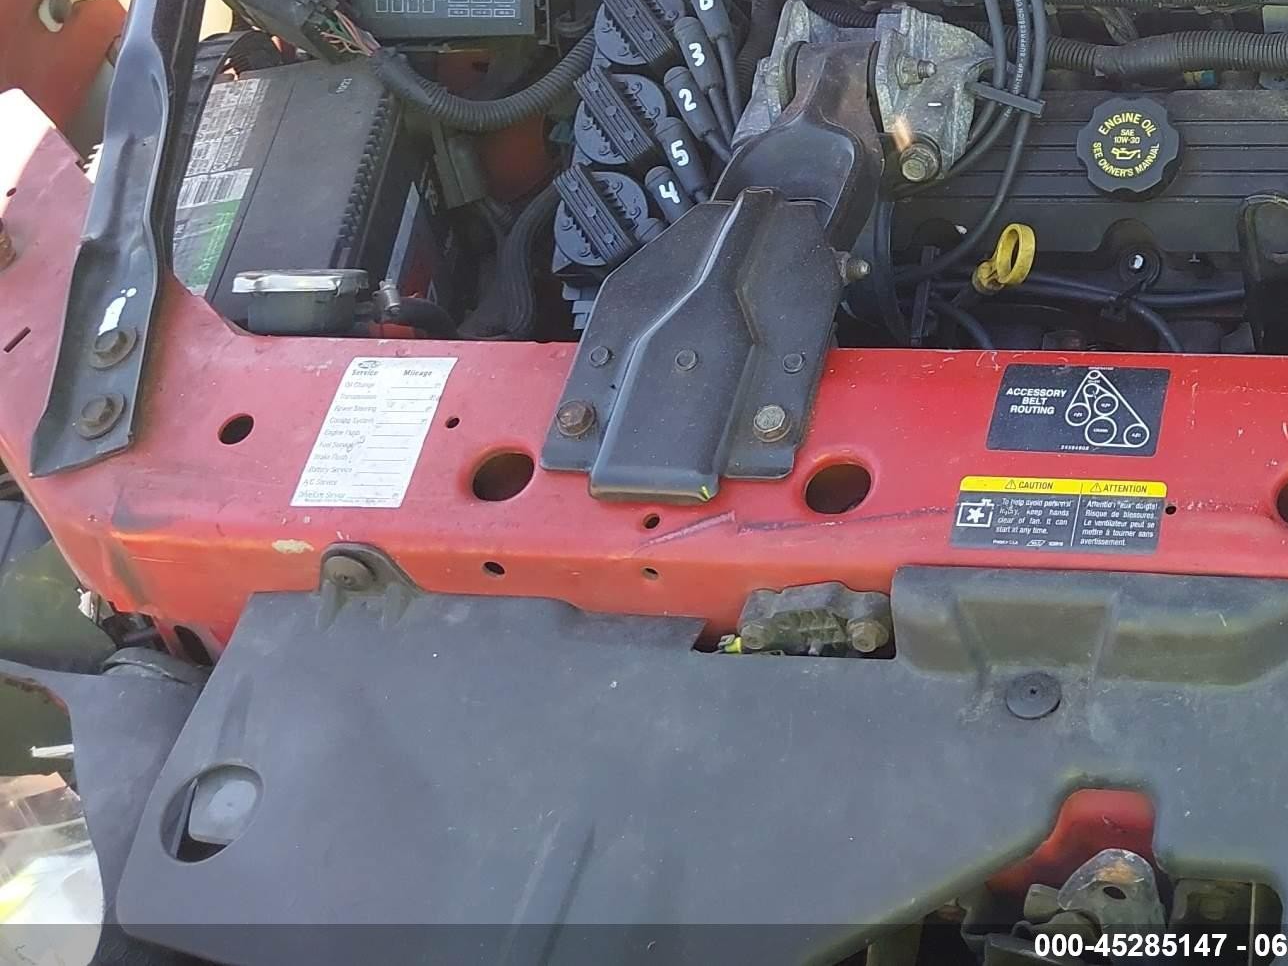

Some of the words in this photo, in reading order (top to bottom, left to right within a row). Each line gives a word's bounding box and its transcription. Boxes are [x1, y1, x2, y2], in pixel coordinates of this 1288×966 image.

[689, 43, 705, 66] 3
[679, 88, 697, 112] 2
[1098, 112, 1142, 136] ENGINE
[1141, 119, 1157, 137] OIL
[1114, 136, 1140, 144] 10W-30
[670, 139, 689, 166] 5
[1093, 142, 1103, 159] SEE
[1098, 158, 1134, 176] OWNER'S
[1135, 143, 1160, 173] MANUAL
[659, 181, 681, 204] 4
[403, 369, 432, 377] Mileage
[1006, 388, 1067, 398] ACCESSORY
[1022, 397, 1048, 405] BELT
[1010, 406, 1055, 415] ROUTING
[1018, 481, 1054, 490] CAUTION
[1103, 484, 1147, 493] ATTENTION
[1085, 510, 1107, 518] Risque
[1094, 519, 1128, 527] ventilateur
[1080, 538, 1126, 546] avertissement.
